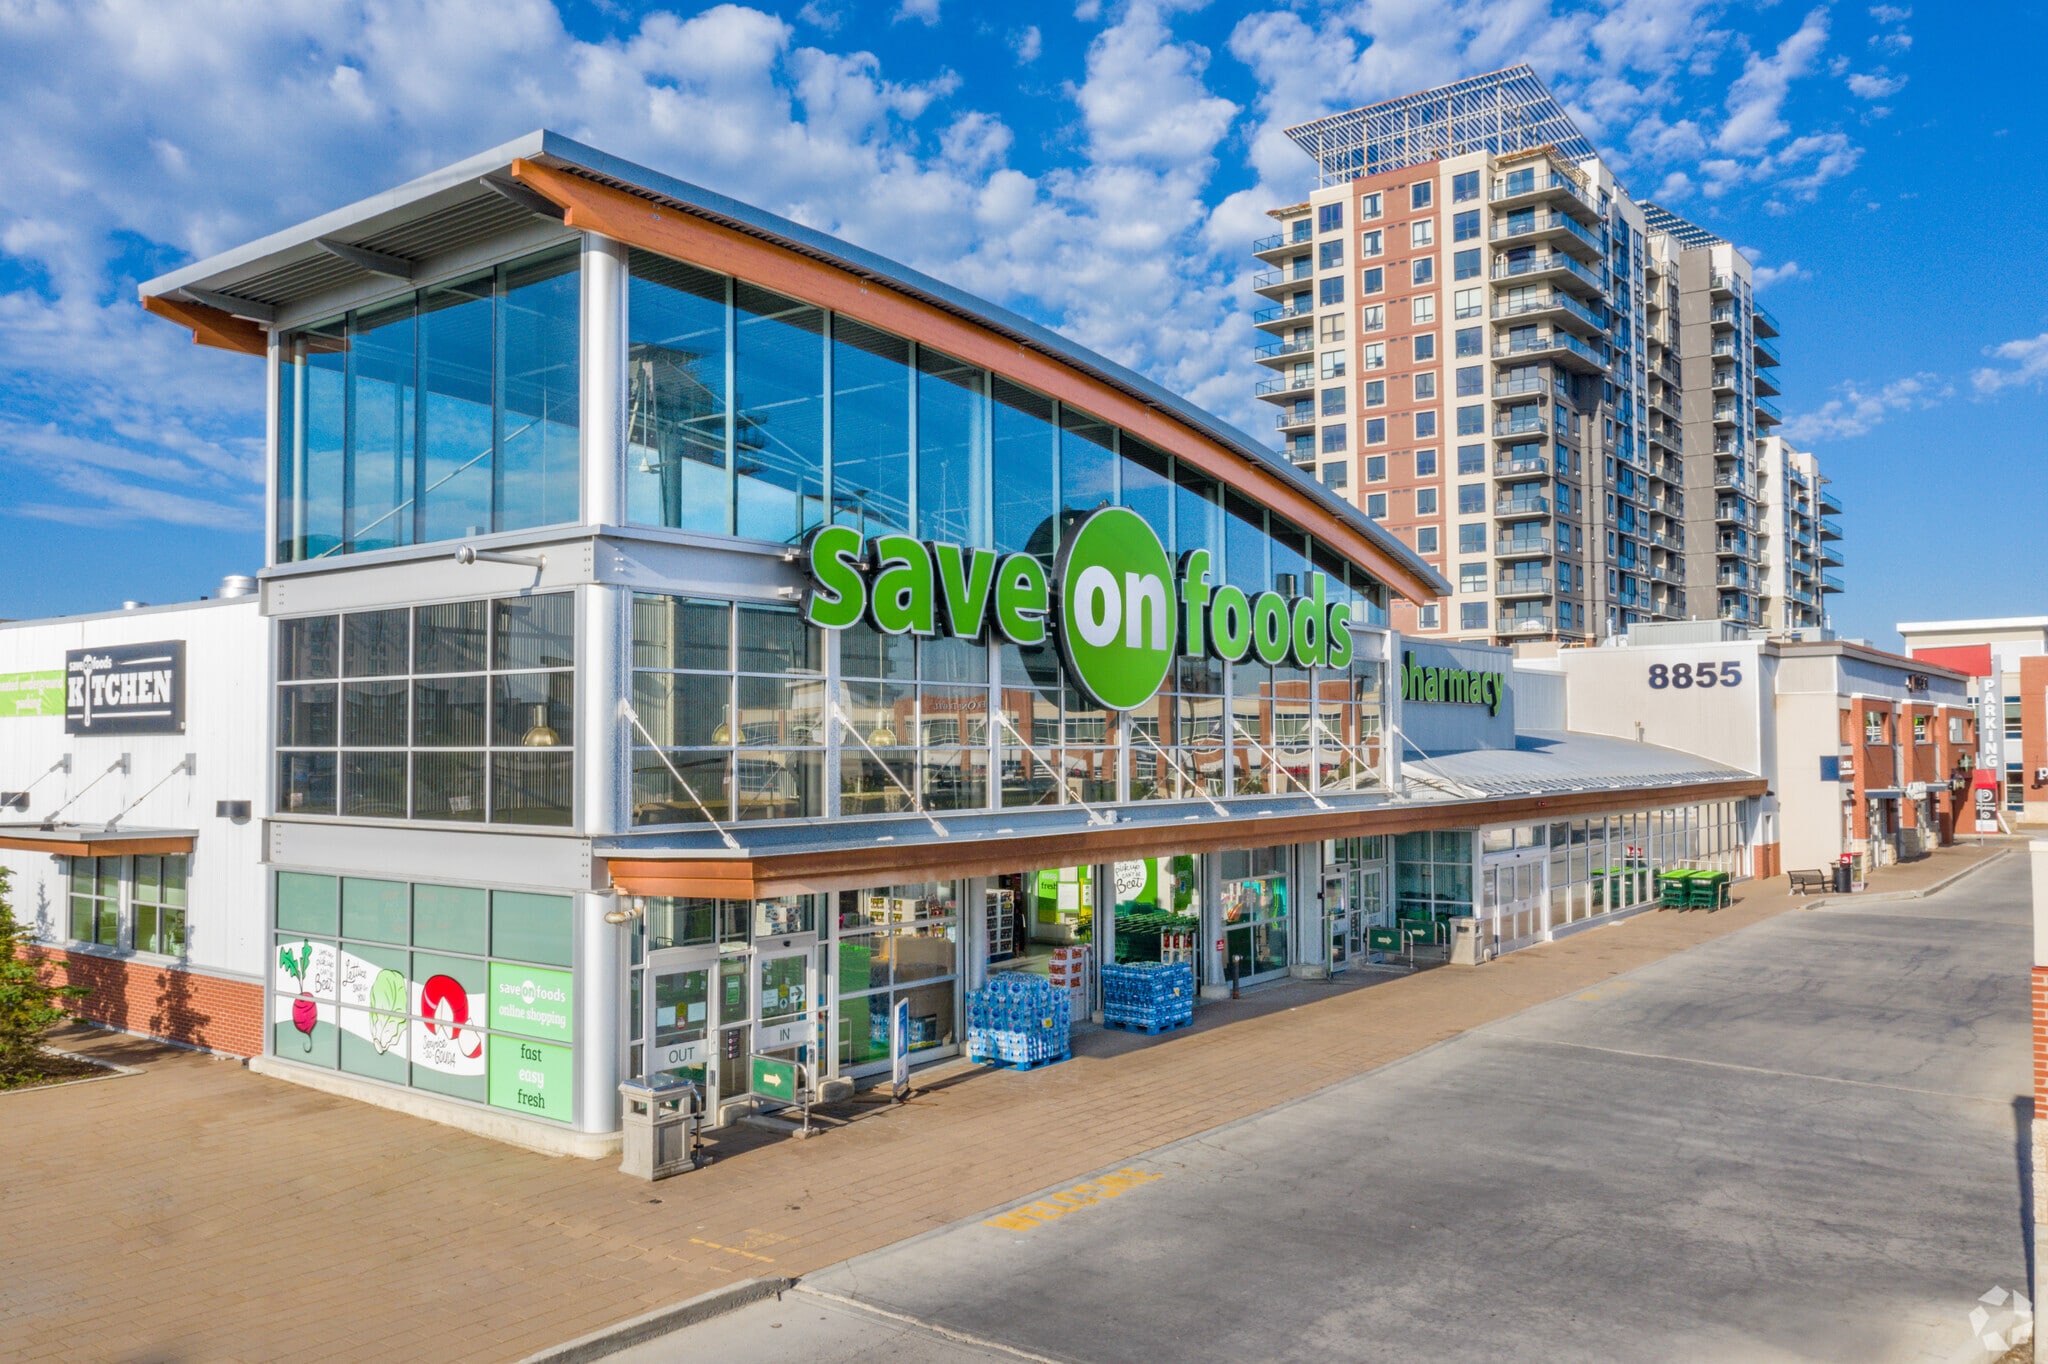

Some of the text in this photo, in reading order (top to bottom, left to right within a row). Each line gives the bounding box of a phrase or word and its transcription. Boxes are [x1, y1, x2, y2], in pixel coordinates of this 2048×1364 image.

[805, 524, 1354, 671] save on foods
[1648, 661, 1742, 689] 8855
[67, 669, 172, 708] KITCHEN
[1984, 679, 1998, 767] PARKING
[499, 983, 566, 1002] save on foods
[499, 1003, 566, 1029] online shopping
[779, 1028, 790, 1042] IN
[520, 1043, 542, 1062] fast
[668, 1047, 695, 1064] OUT
[518, 1068, 545, 1088] easy
[517, 1088, 546, 1109] fresh
[983, 1167, 1164, 1232] WELCOME
